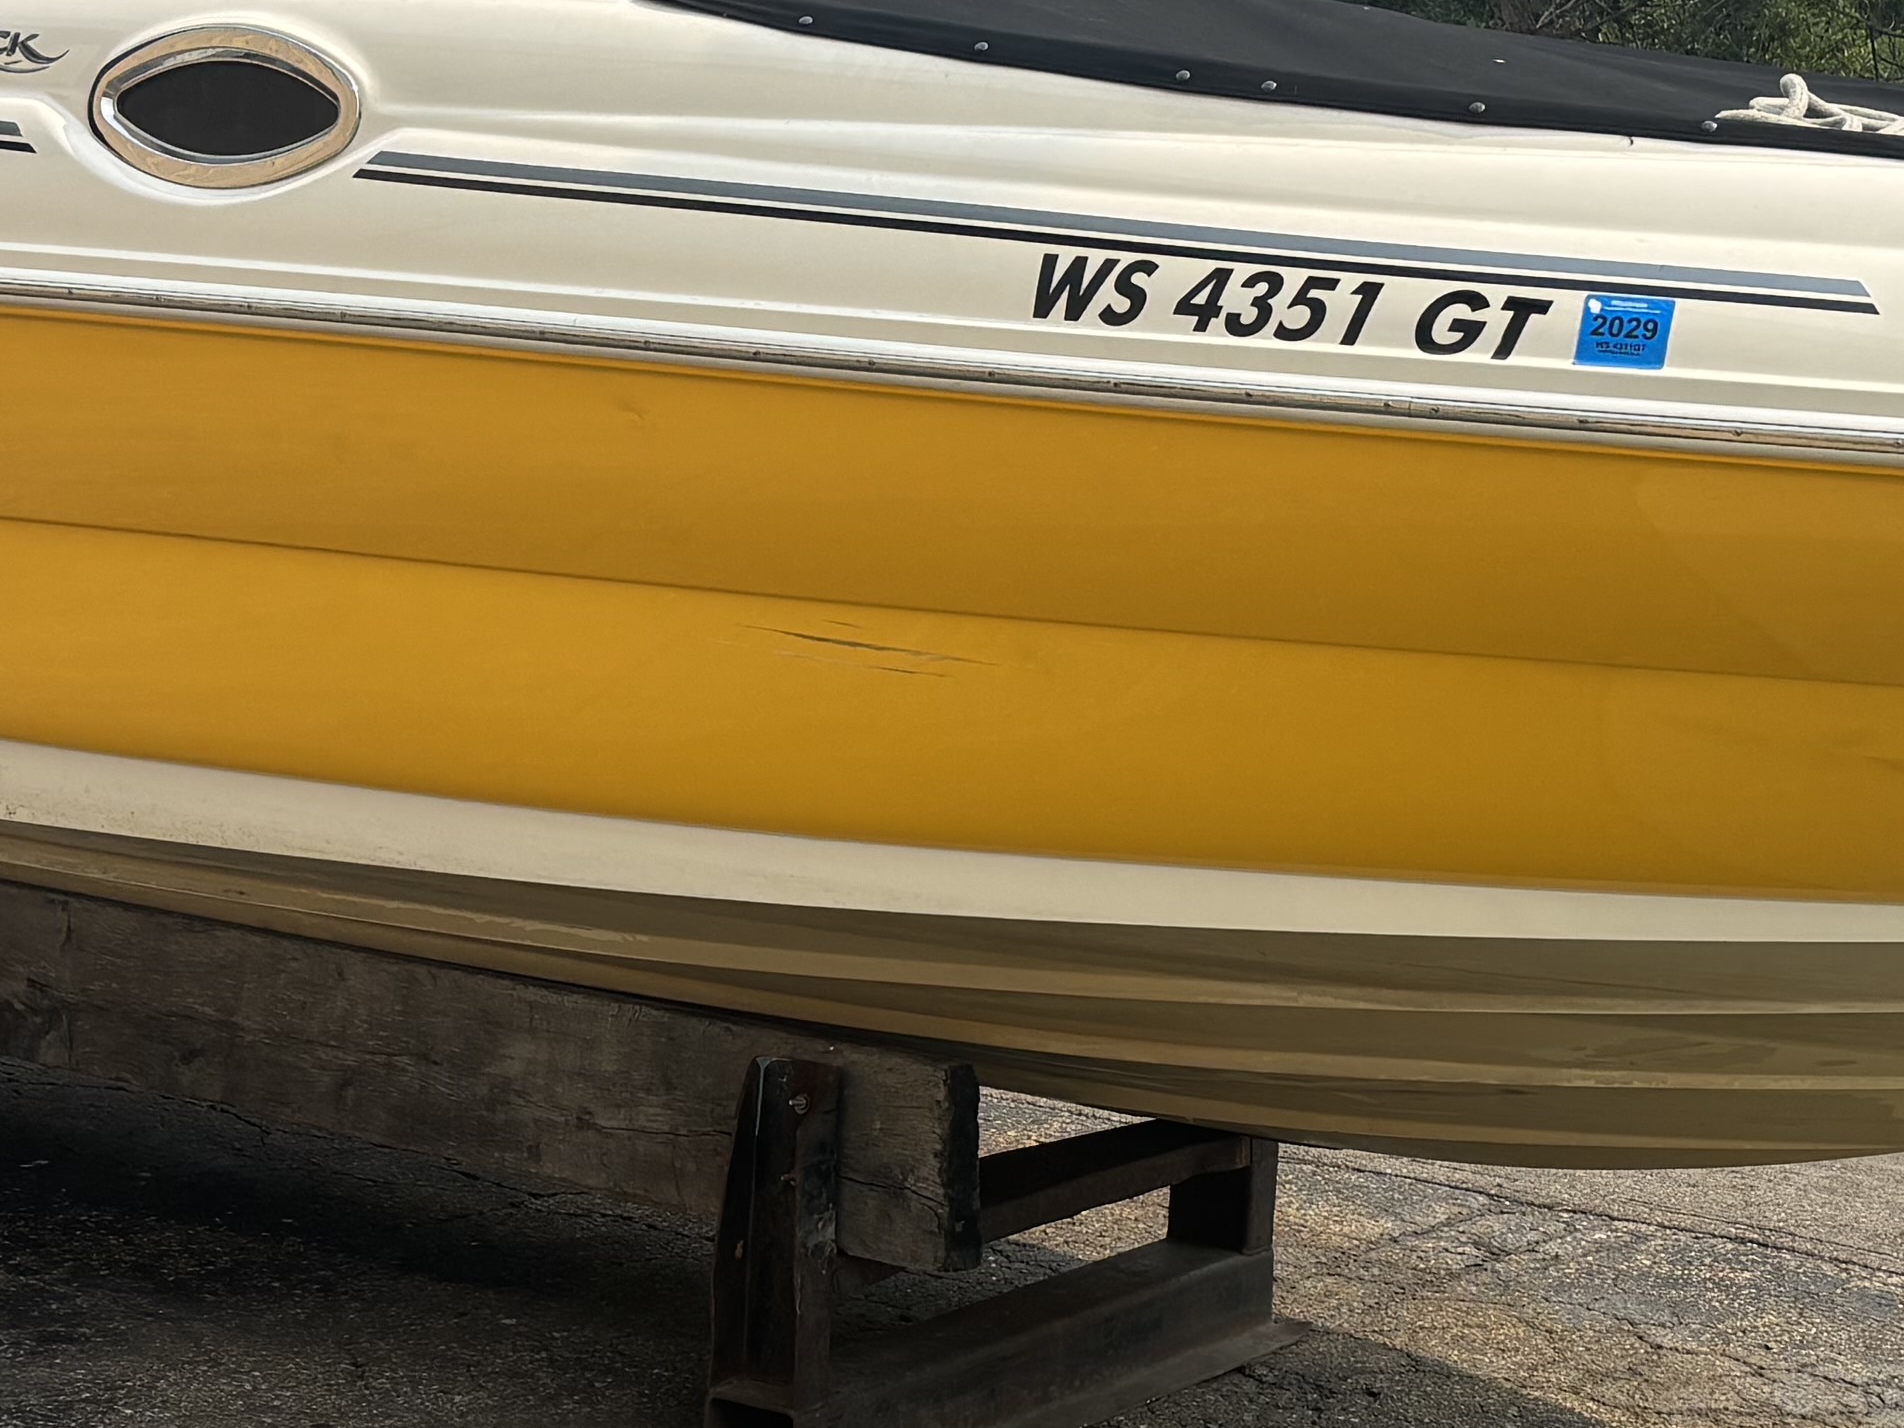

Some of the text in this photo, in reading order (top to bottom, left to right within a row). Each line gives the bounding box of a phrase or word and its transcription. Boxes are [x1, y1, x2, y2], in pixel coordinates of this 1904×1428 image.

[1032, 253, 1554, 361] WS 4351 GT
[1589, 314, 1659, 341] 2029
